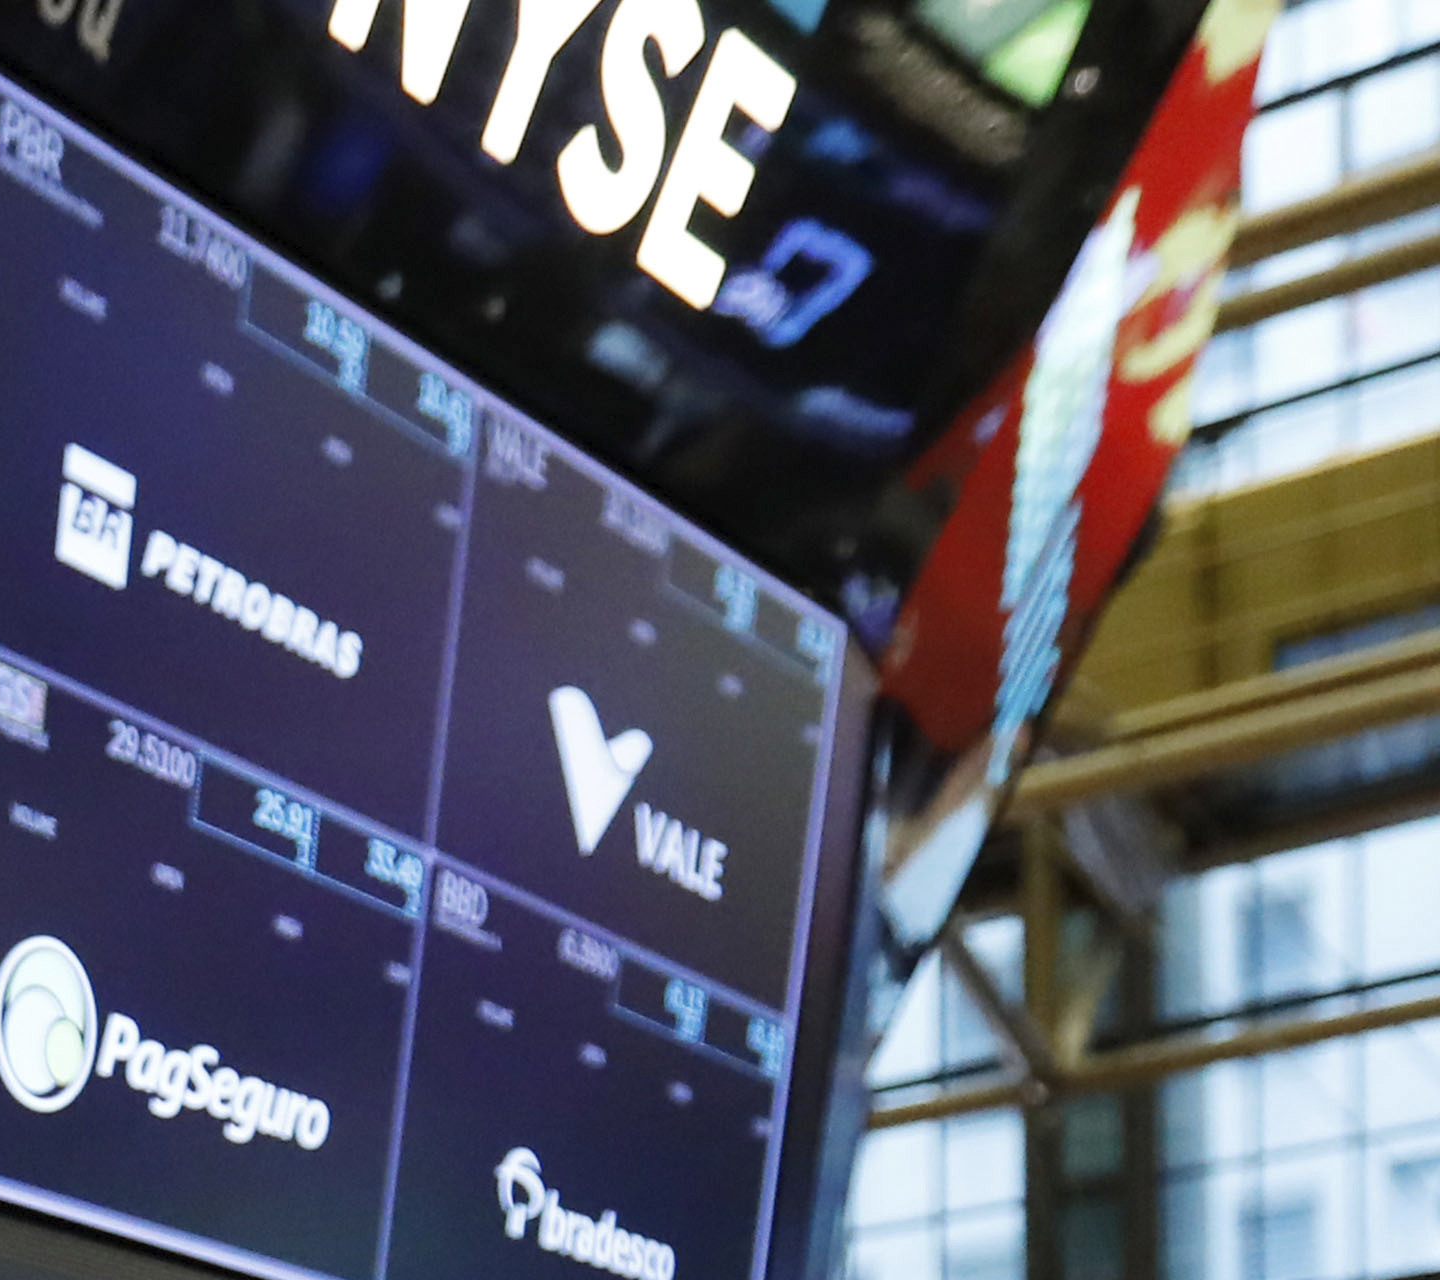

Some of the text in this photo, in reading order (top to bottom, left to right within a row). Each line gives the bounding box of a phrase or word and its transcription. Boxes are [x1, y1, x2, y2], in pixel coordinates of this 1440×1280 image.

[140, 529, 364, 680] PETROBRAS
[633, 800, 729, 900] VALE
[95, 1010, 333, 1153] PagSeguro
